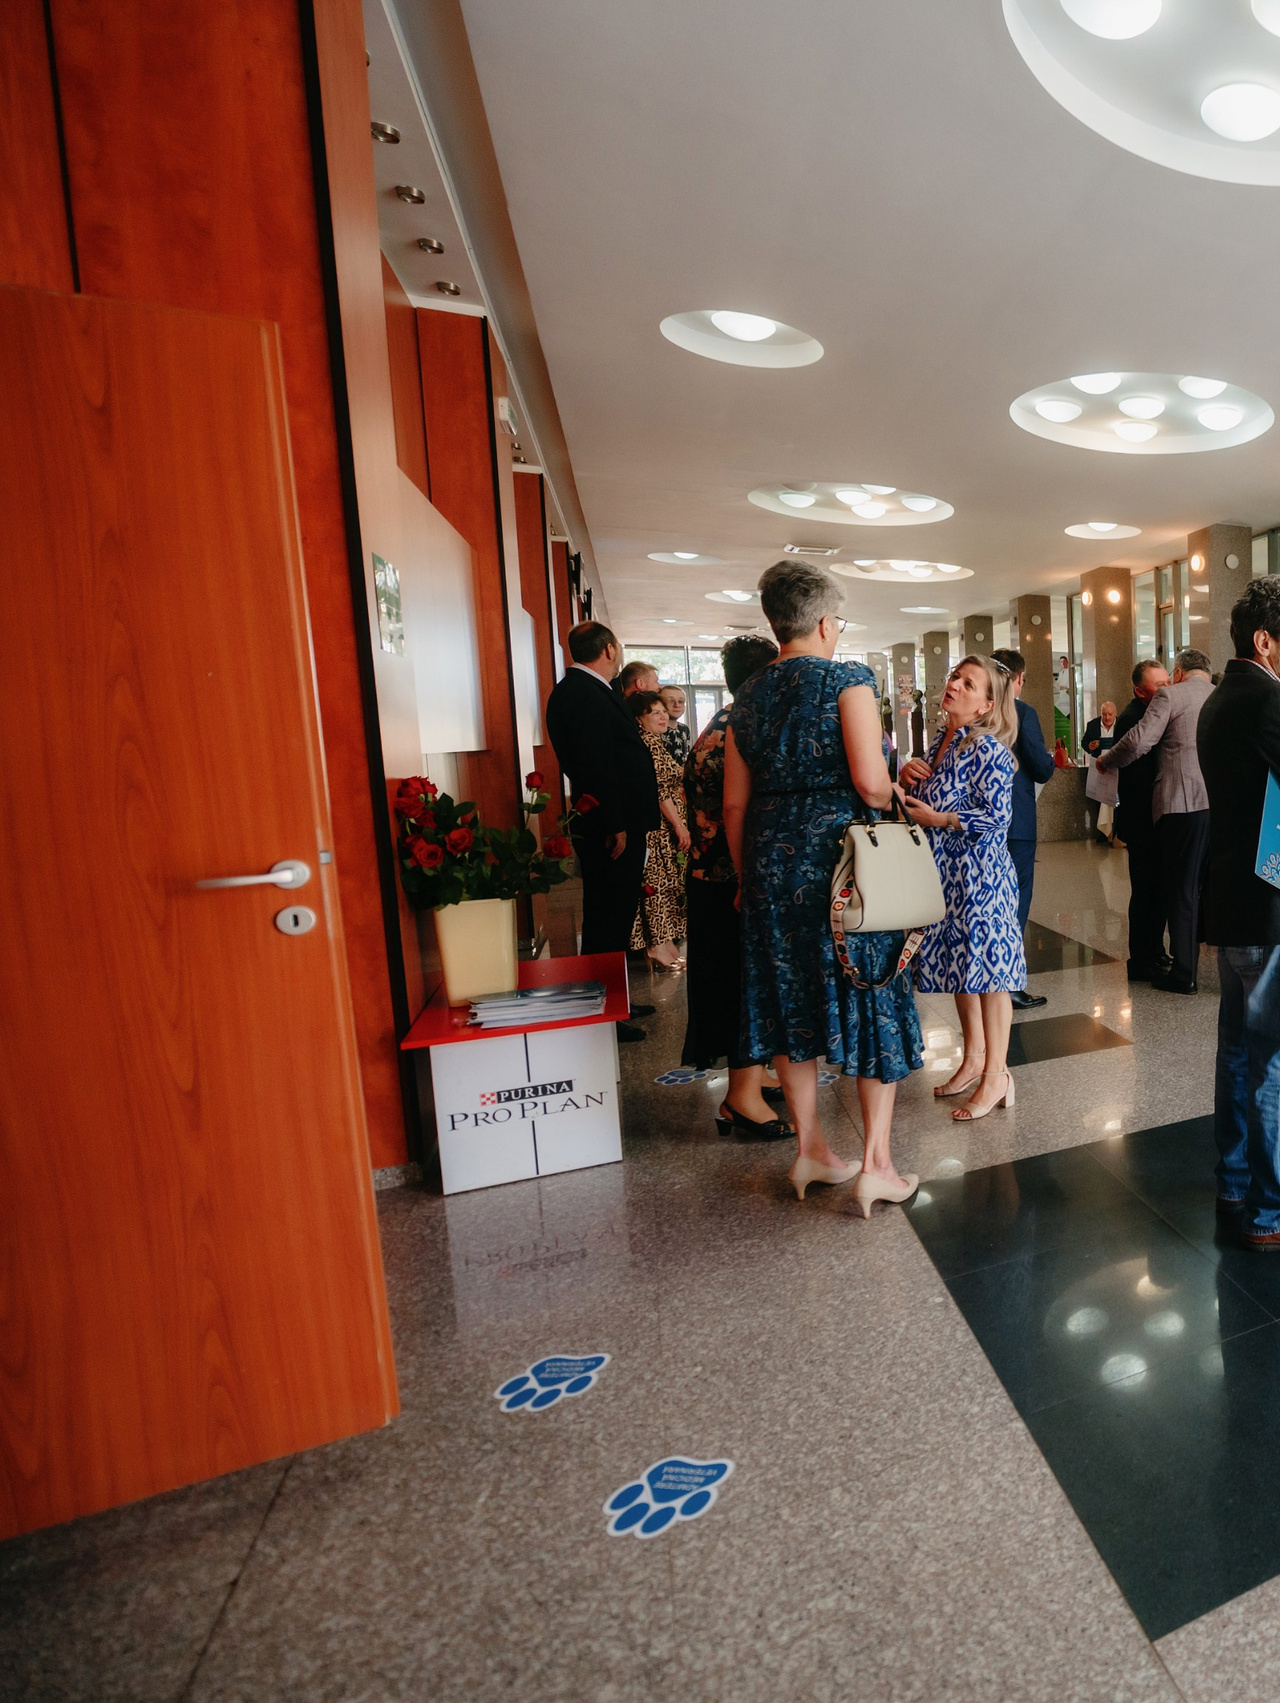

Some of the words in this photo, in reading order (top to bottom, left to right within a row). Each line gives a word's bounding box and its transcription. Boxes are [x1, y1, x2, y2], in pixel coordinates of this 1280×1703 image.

[500, 1081, 572, 1102] PURINA
[448, 1108, 512, 1132] PRO
[518, 1091, 606, 1120] PLAN
